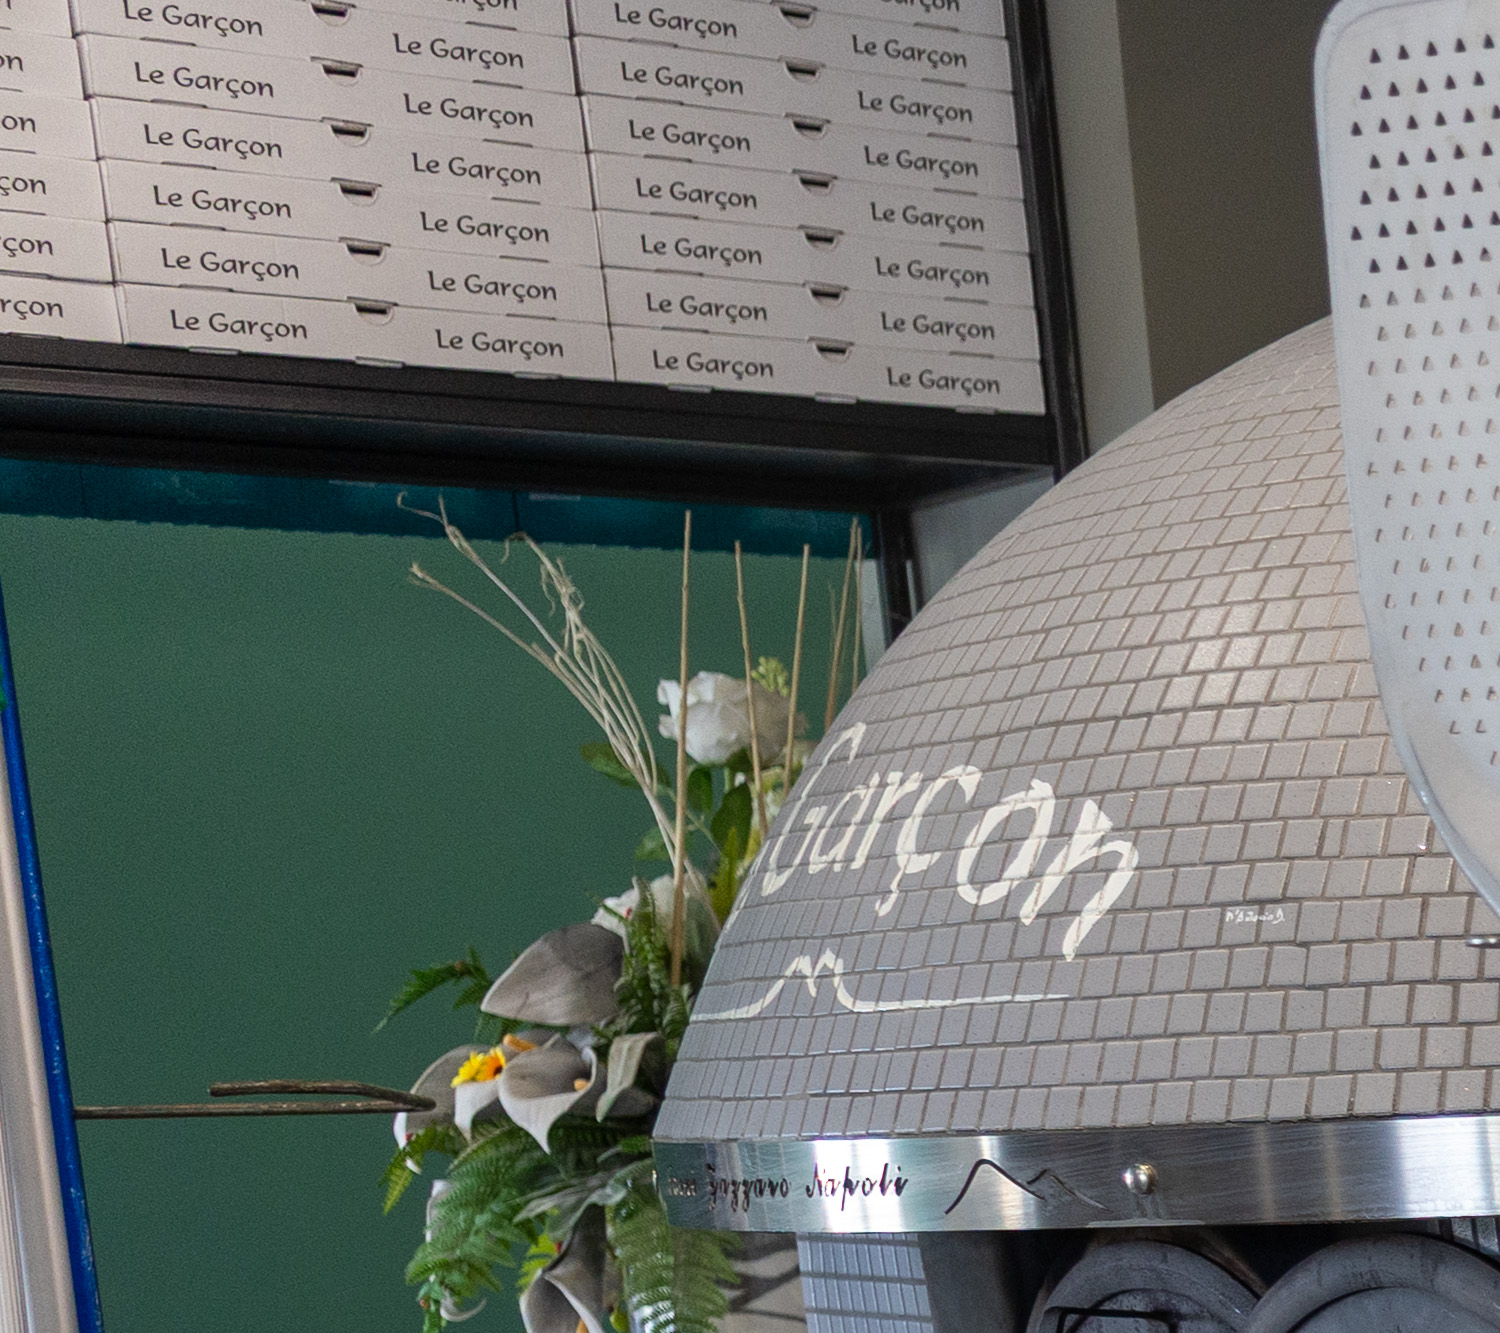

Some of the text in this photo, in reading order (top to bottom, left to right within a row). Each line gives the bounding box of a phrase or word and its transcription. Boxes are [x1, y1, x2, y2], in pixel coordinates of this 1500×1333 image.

[123, 0, 262, 37] Le Garçon
[614, 2, 737, 39] Le Garçon
[393, 33, 523, 69] Le Garçon
[852, 35, 967, 69] Le Garçon
[134, 62, 274, 99] Le Garçon
[620, 62, 743, 96] Le Garçon
[403, 93, 533, 129] Le Garçon
[858, 91, 972, 124] Le Garçon
[143, 124, 282, 160] Le Garçon
[629, 119, 750, 154] Le Garçon
[412, 152, 541, 186] Le Garçon
[864, 146, 978, 178] Le Garçon
[0, 176, 47, 197] çon
[153, 185, 291, 220] Le Garçon
[636, 178, 757, 210] Le Garçon
[420, 211, 549, 245] Le Garçon
[870, 202, 984, 234] Le Garçon
[2, 237, 54, 258] çon
[641, 234, 762, 267] Le Garçon
[161, 248, 299, 281] Le Garçon
[875, 257, 989, 288] Le Garçon
[428, 270, 557, 303] Le Garçon
[0, 299, 64, 321] rçon
[646, 292, 767, 323] Le Garçon
[170, 309, 307, 342] Le Garçon
[881, 312, 994, 341] Le Garçon
[435, 329, 563, 360] Le Garçon
[653, 350, 773, 379] Le Garçon
[887, 367, 1000, 395] Le Garçon
[760, 722, 1139, 962] Garçon
[805, 1162, 909, 1212] Napoli
